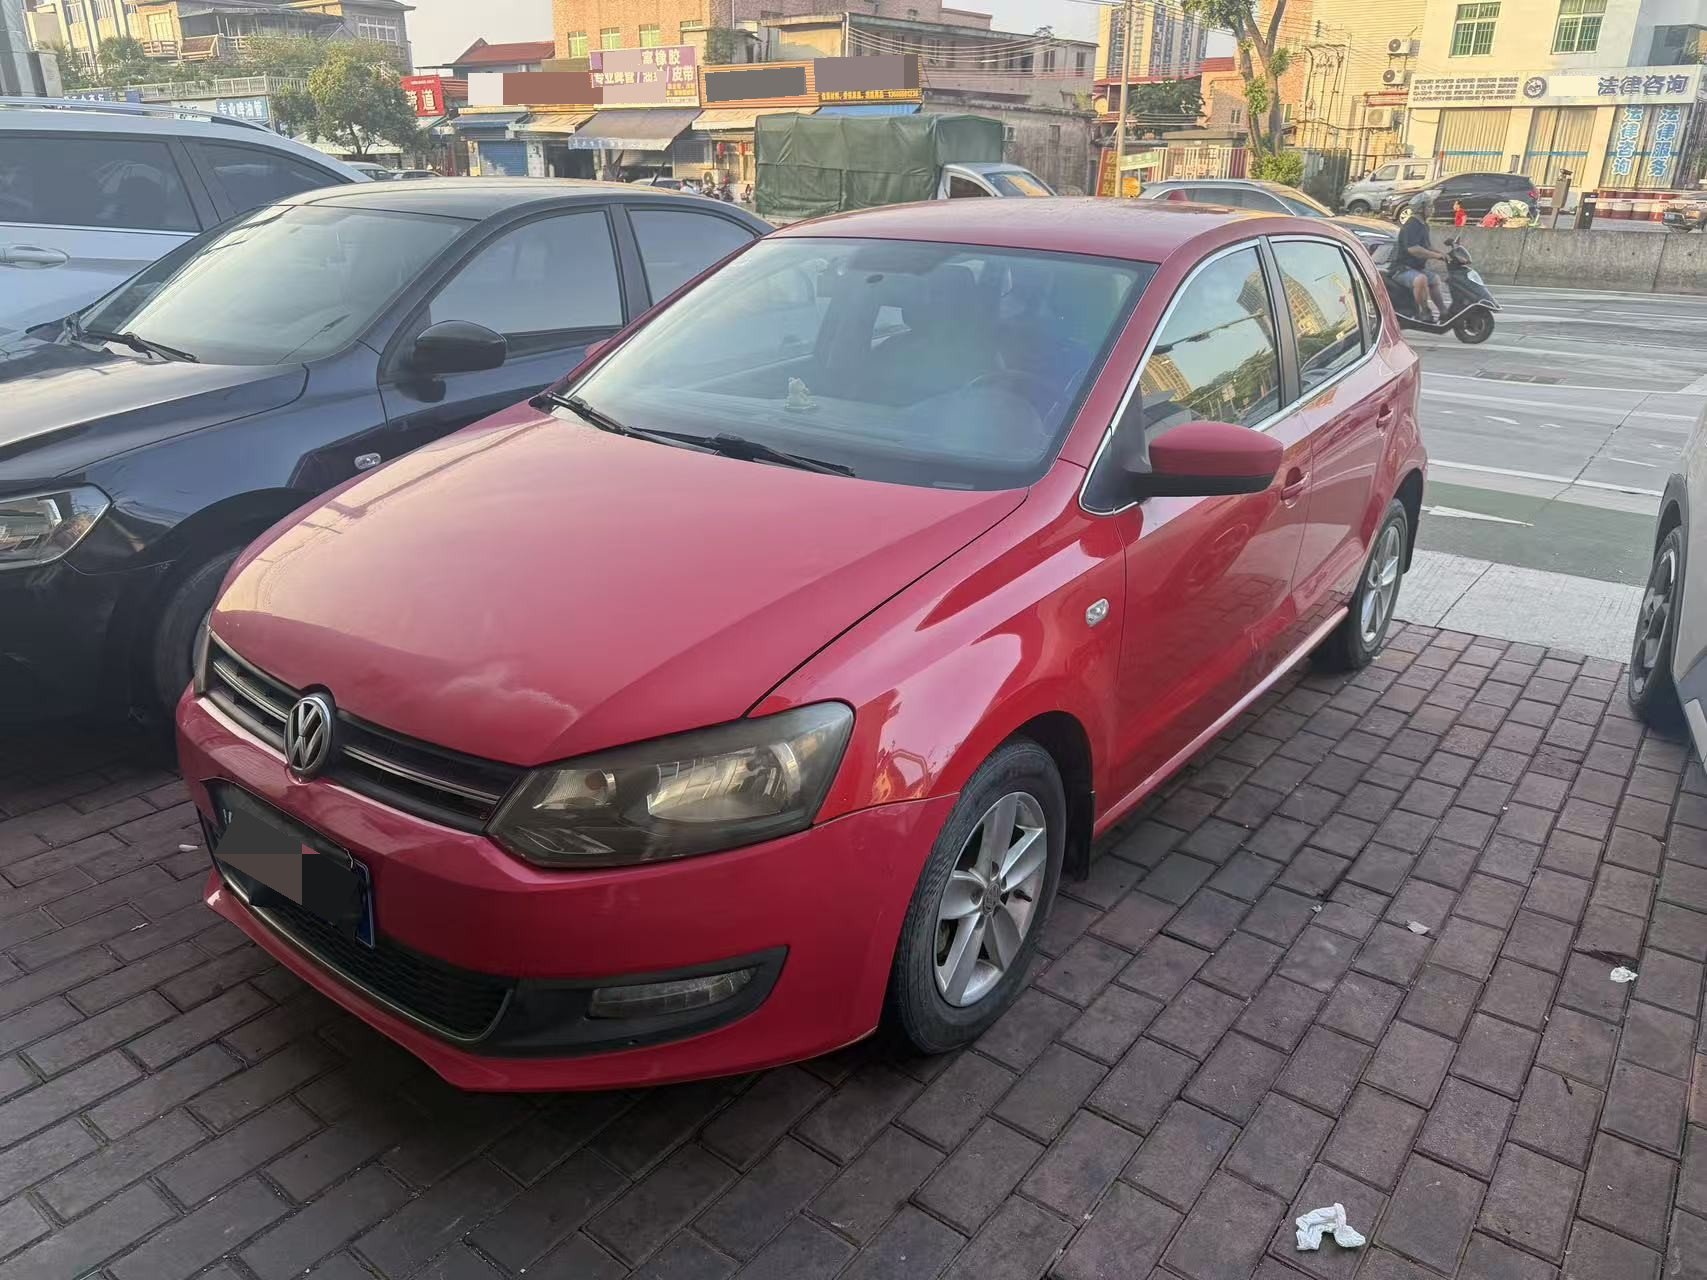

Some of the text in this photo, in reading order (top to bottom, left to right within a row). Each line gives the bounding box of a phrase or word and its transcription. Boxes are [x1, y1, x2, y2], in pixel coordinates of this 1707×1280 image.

[1598, 74, 1689, 96] 法律咨询
[1612, 104, 1644, 175] 法律咨询
[1649, 105, 1680, 176] 法律服务
